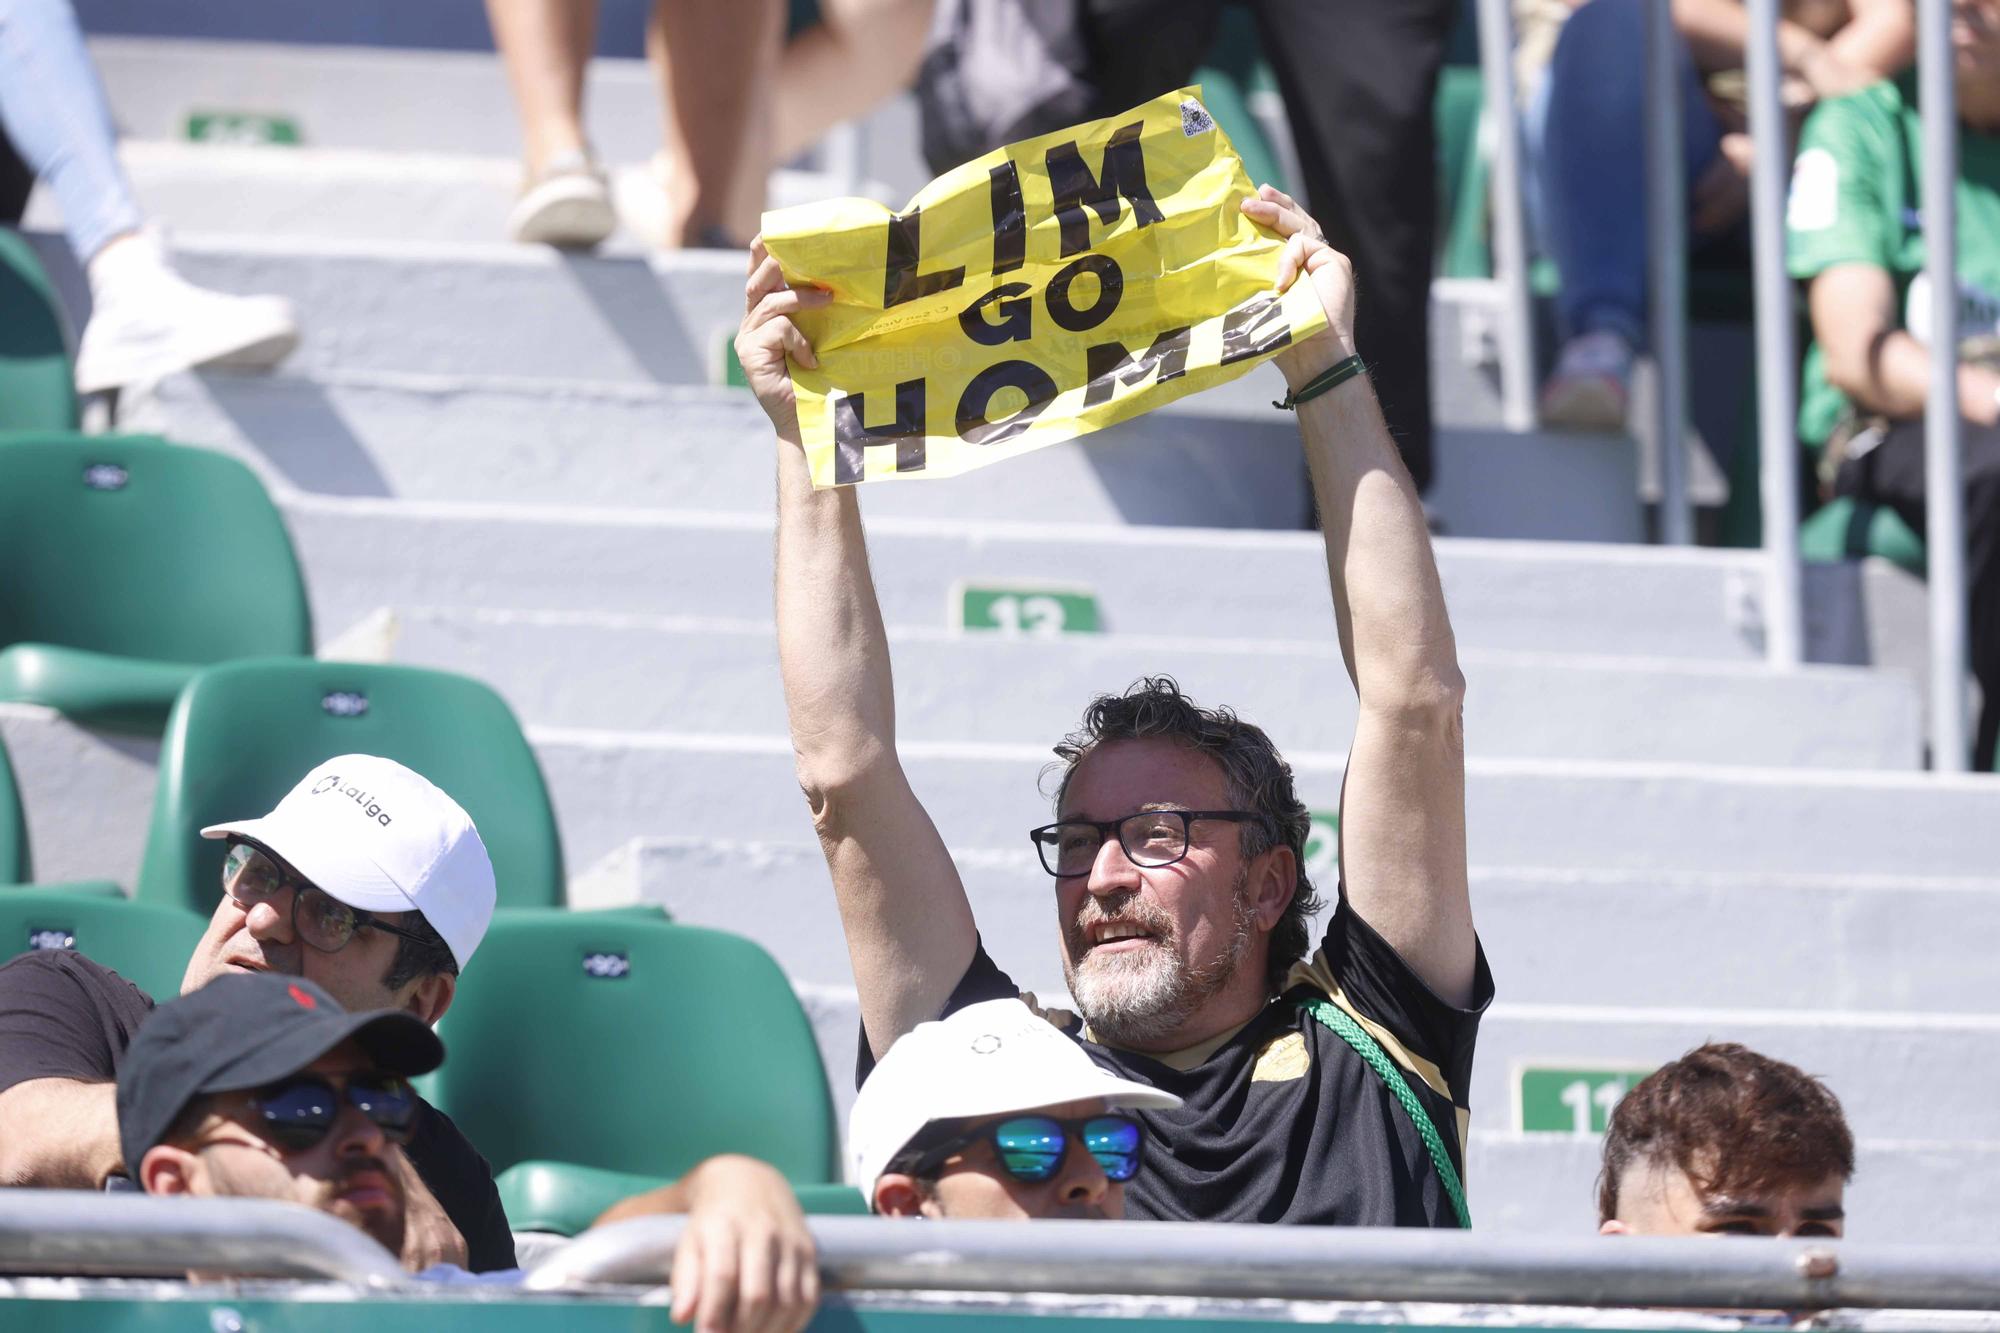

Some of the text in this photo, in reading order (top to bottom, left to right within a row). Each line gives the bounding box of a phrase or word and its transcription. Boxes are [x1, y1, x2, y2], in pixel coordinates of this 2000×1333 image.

[885, 120, 1164, 309] LIM
[958, 254, 1123, 347] GO
[834, 297, 1292, 485] HOME
[338, 782, 392, 827] LaLiga
